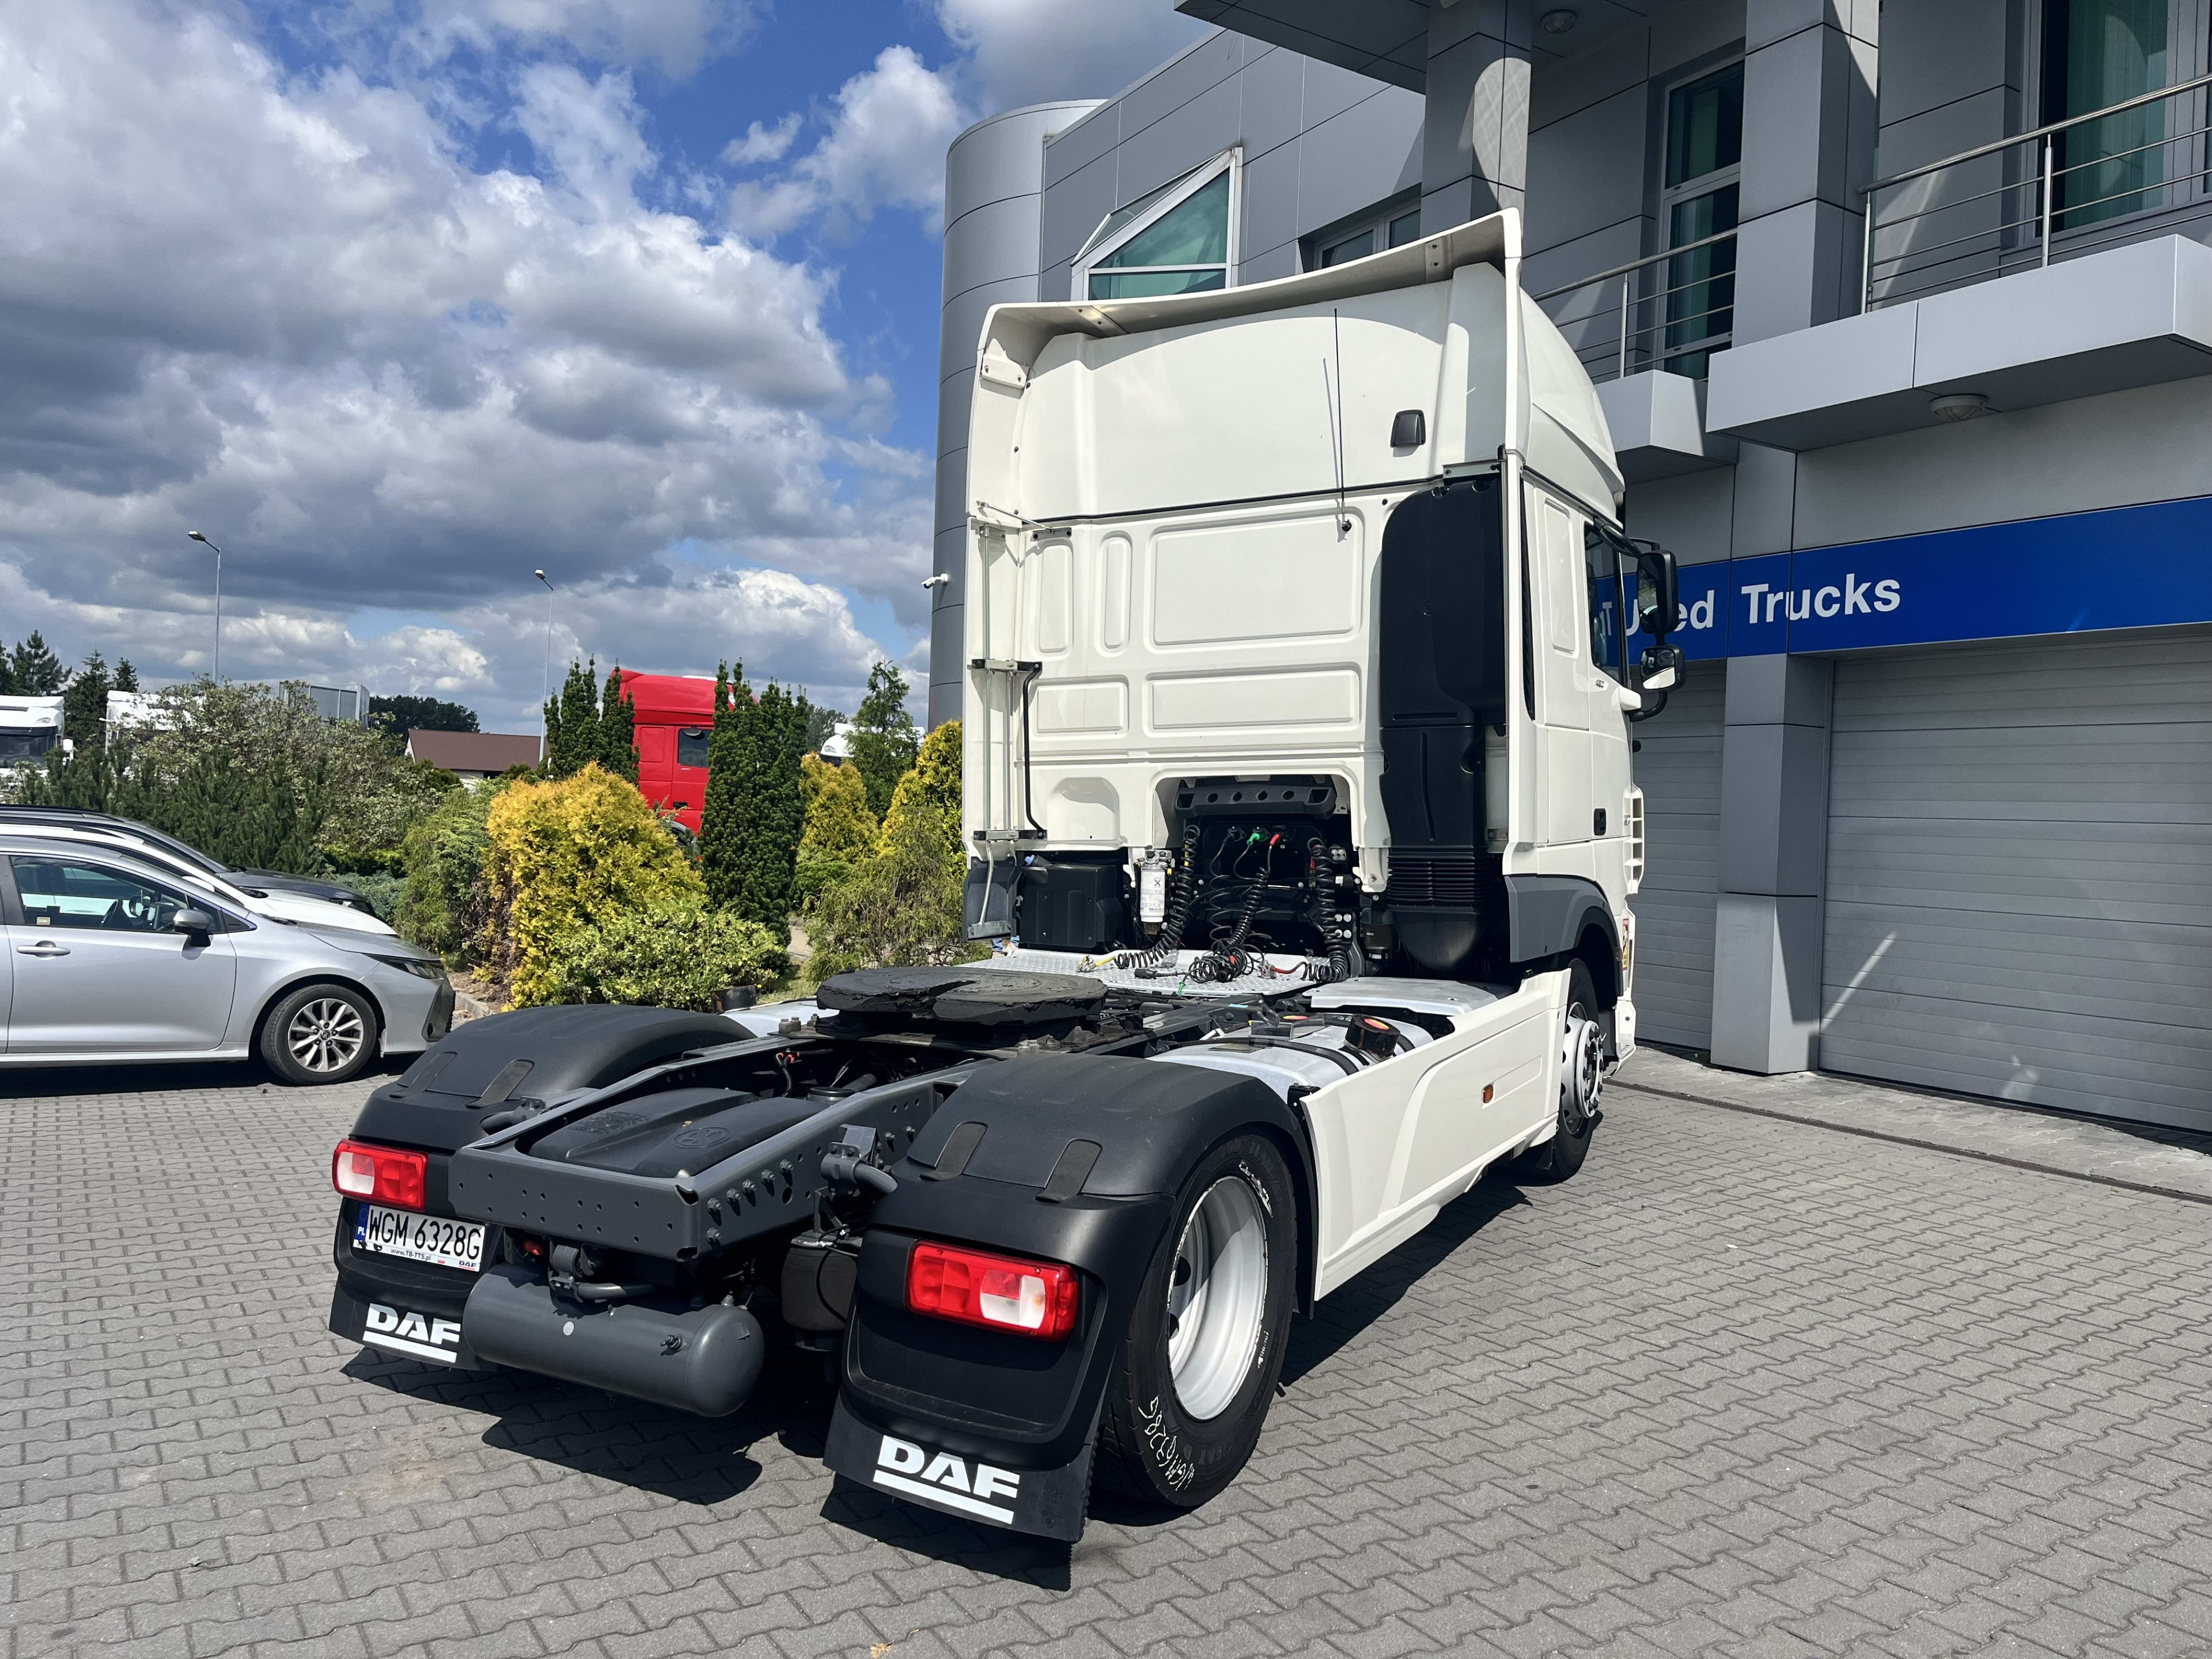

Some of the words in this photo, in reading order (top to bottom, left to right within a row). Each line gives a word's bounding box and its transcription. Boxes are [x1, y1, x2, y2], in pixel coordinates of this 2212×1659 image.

[1626, 590, 1714, 636] Ued
[1741, 573, 1901, 624] Trucks
[358, 1226, 365, 1236] PL
[369, 1209, 409, 1247] WGM
[414, 1219, 481, 1260] 6328G
[391, 1248, 431, 1262] www.TB-TTS.pl
[365, 1303, 461, 1345] DAF
[877, 1435, 1020, 1499] DAF
